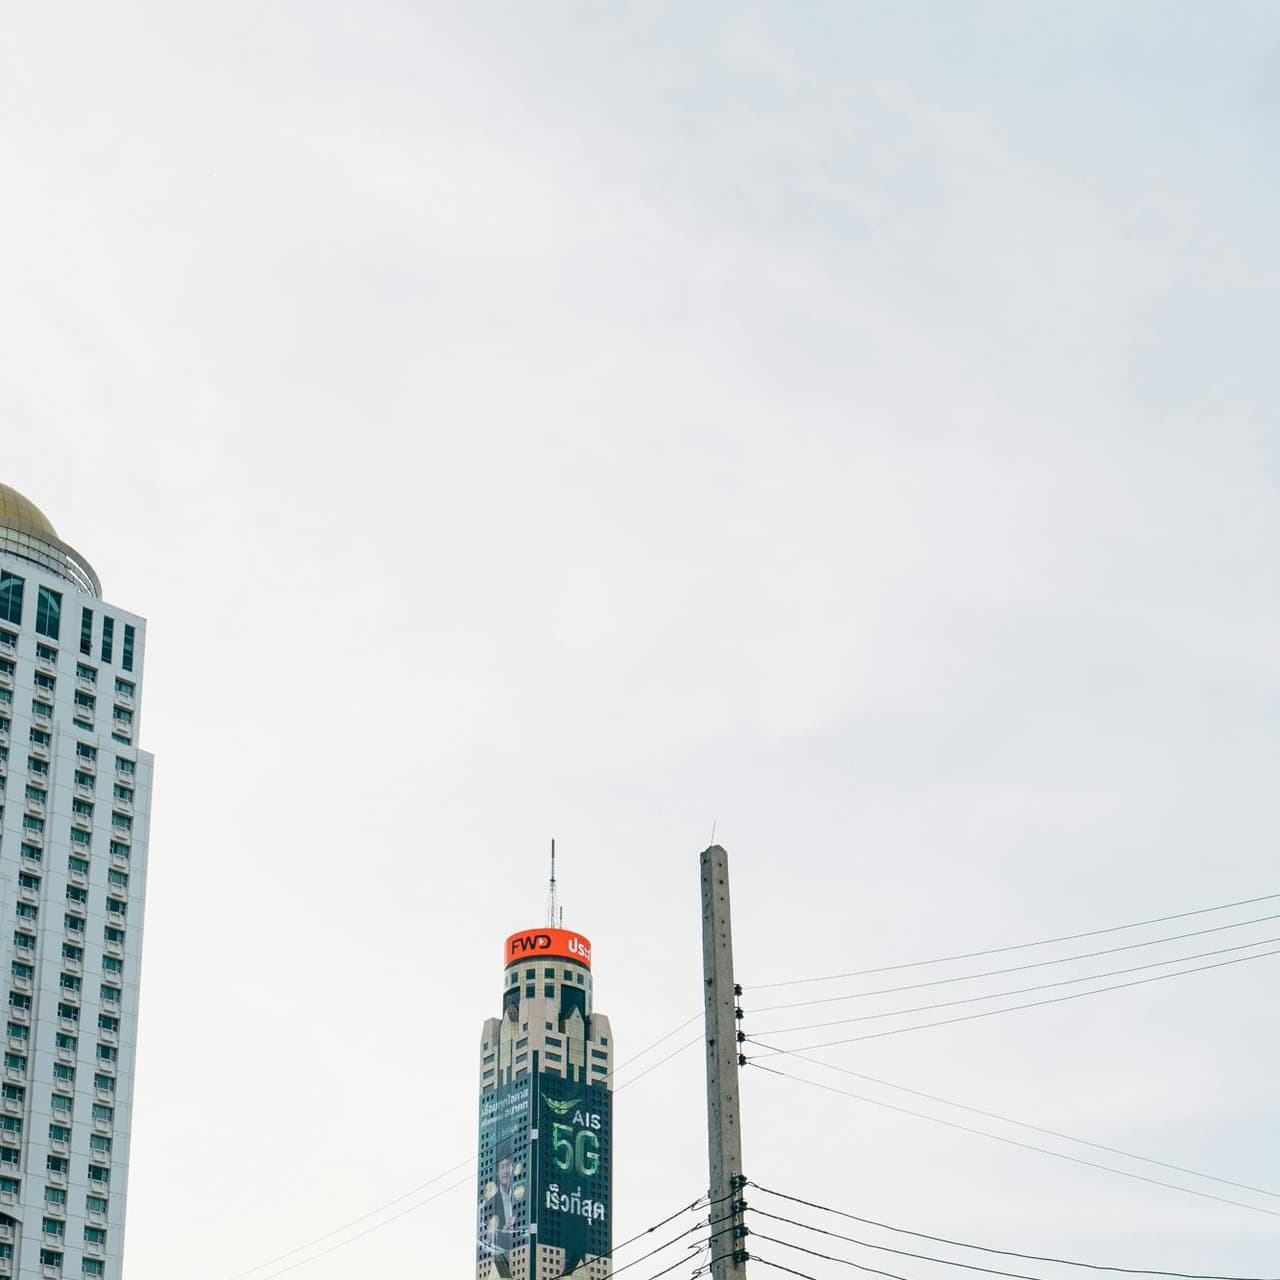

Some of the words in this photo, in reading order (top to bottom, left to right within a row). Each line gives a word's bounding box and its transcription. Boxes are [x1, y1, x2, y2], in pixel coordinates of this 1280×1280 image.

[511, 934, 551, 955] FWD
[572, 1110, 601, 1130] AIS
[552, 1122, 600, 1176] 5G
[545, 1183, 605, 1226] เร็วที่สุด
